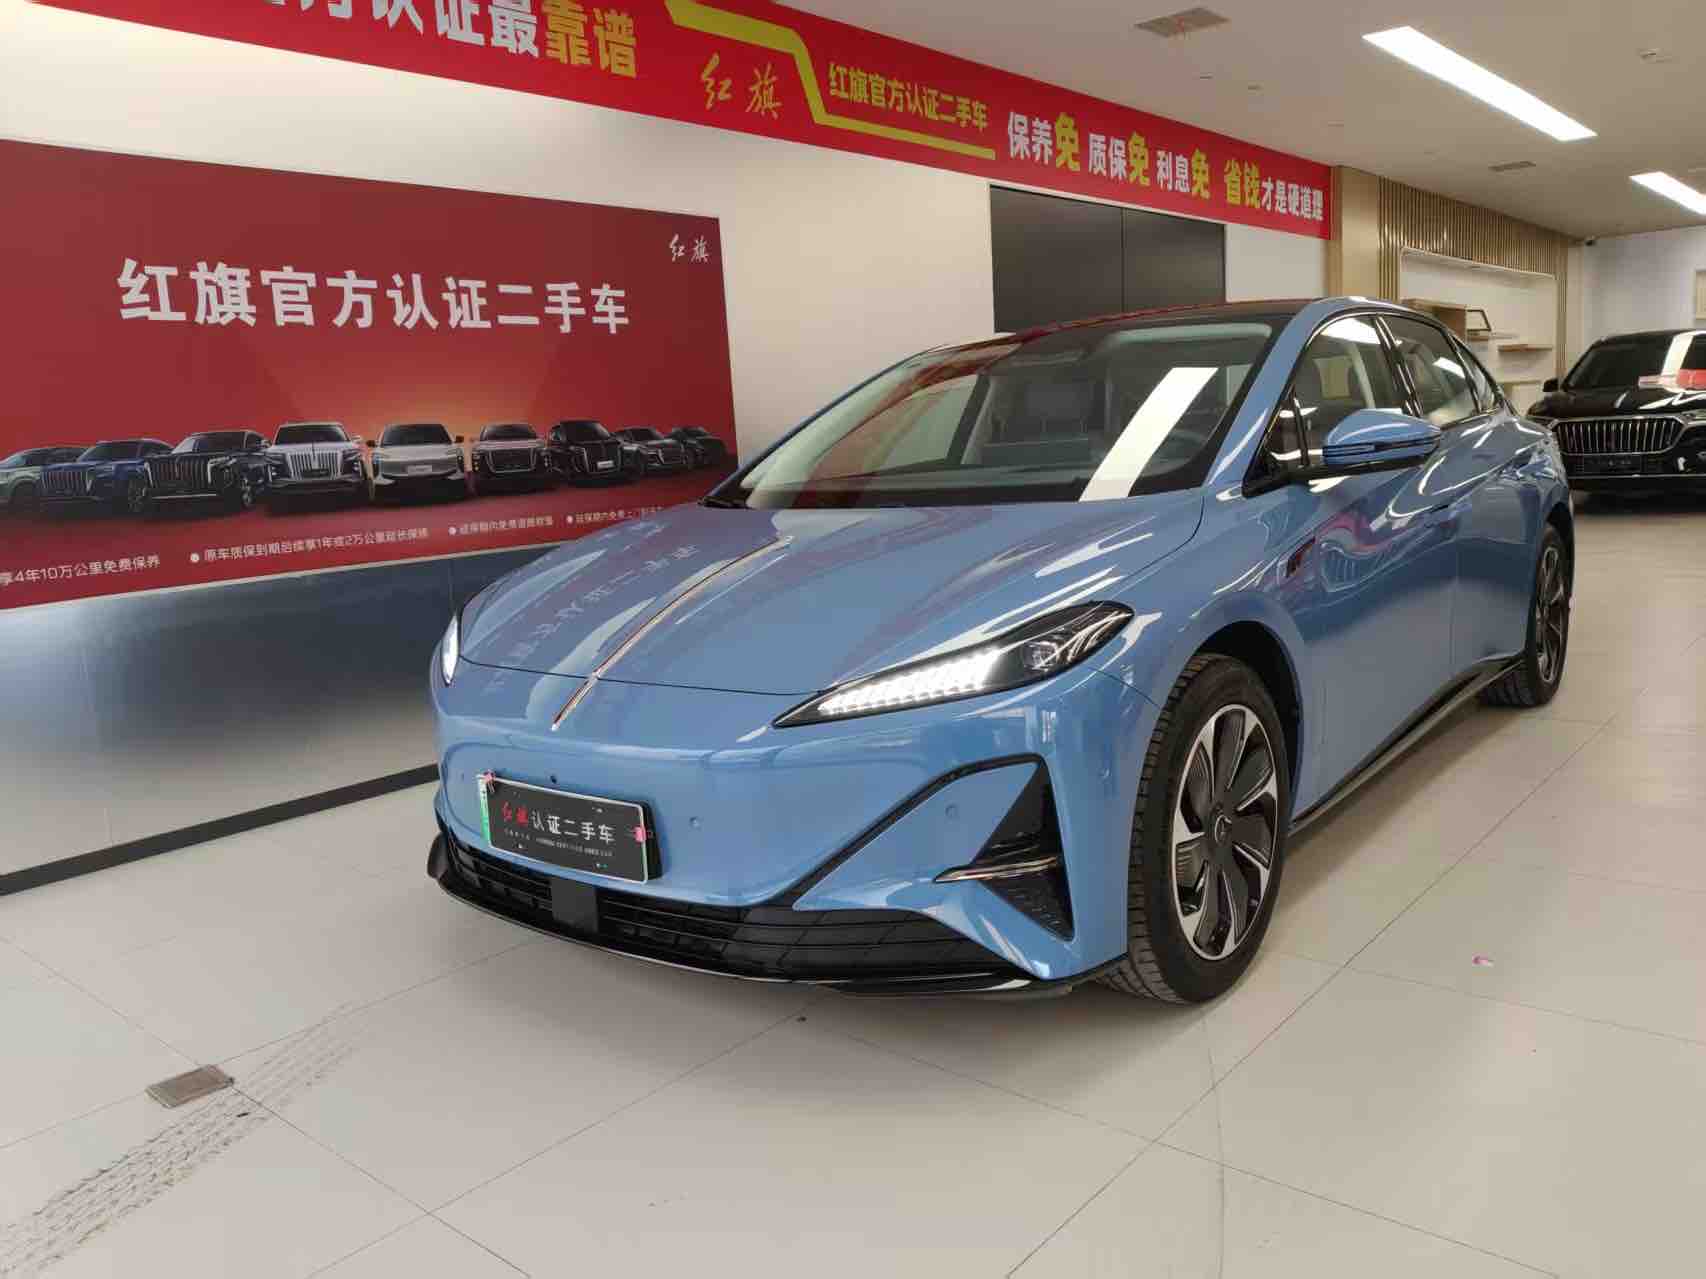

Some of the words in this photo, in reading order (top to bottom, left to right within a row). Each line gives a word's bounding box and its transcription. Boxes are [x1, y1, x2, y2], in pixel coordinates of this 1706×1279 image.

[701, 53, 783, 119] 红旗
[828, 61, 989, 132] 红旗官方认证二手车
[669, 233, 709, 262] 红旗
[117, 258, 630, 335] 红旗官方认证二手车
